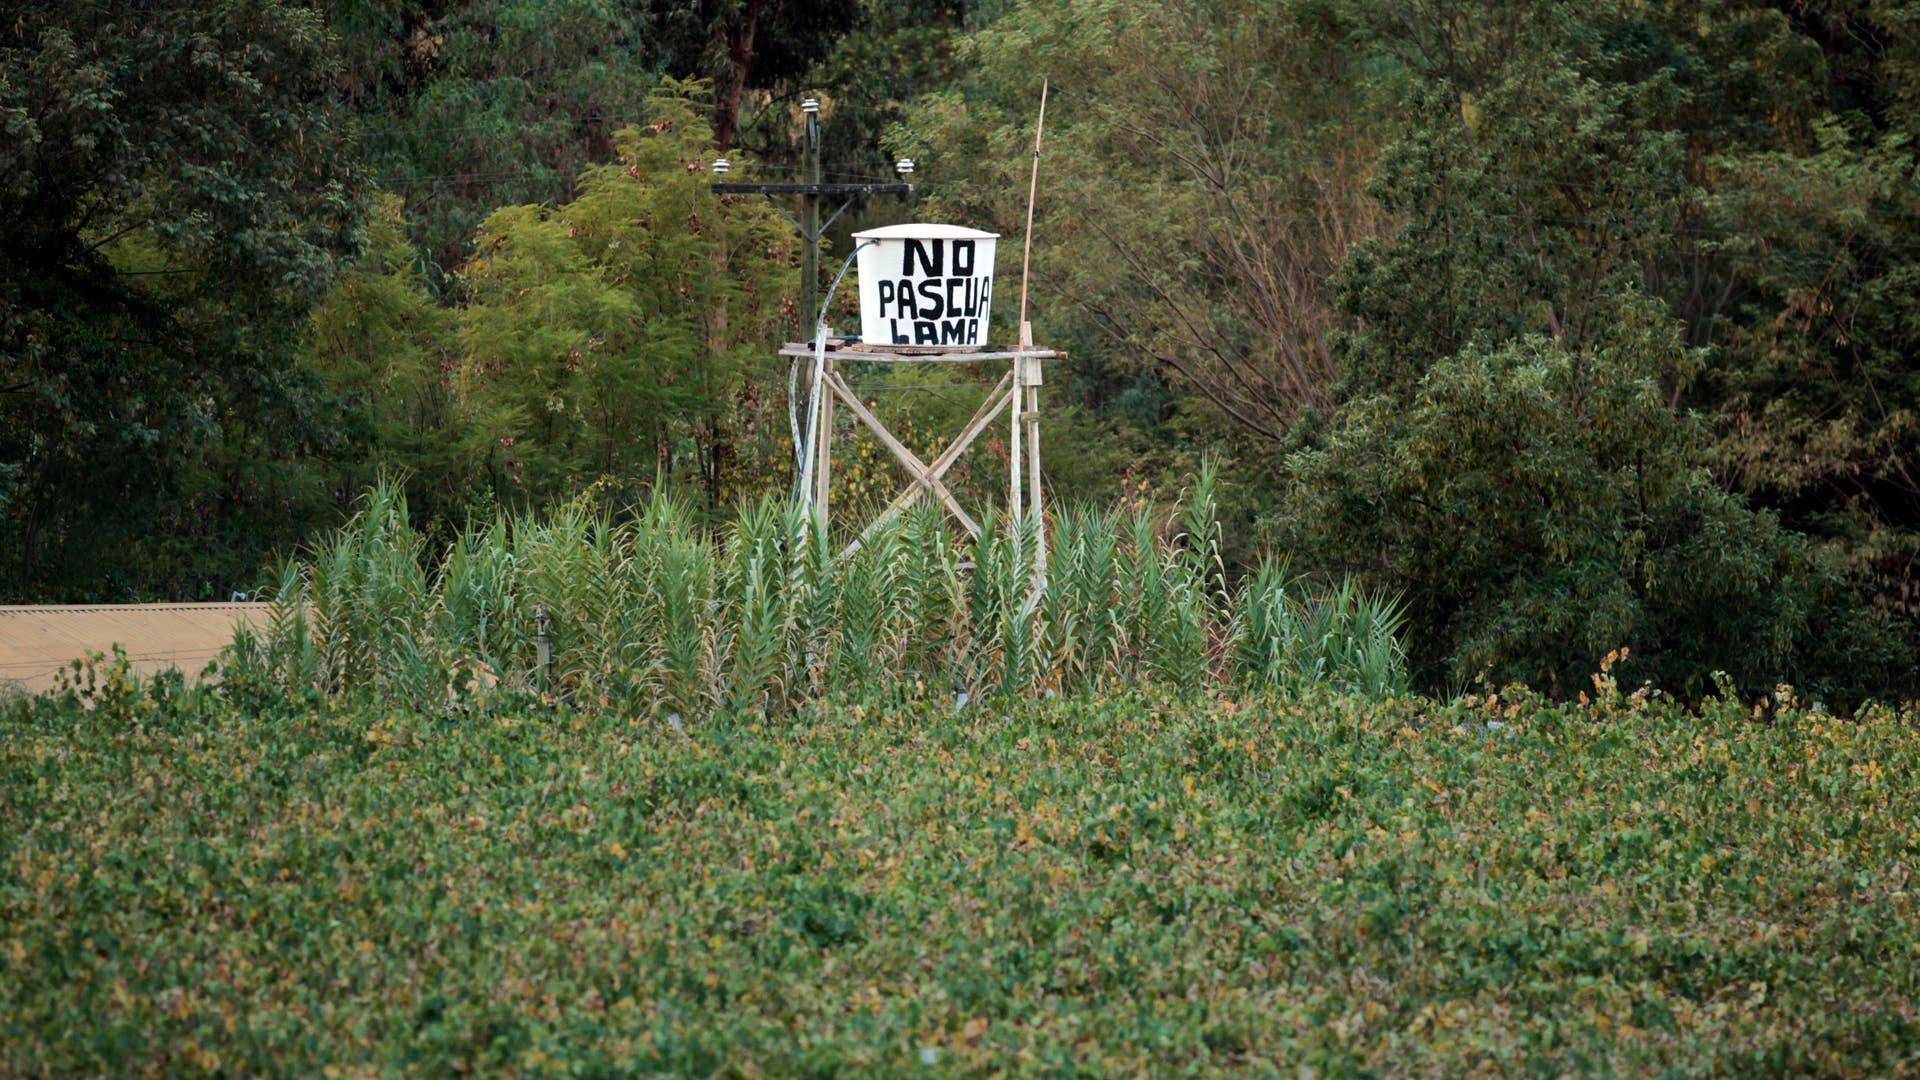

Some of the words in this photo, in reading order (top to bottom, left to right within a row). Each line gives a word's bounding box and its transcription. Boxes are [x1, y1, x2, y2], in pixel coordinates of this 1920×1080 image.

[903, 238, 975, 277] NO
[878, 276, 990, 321] PASCUA
[890, 318, 978, 345] LAMA
